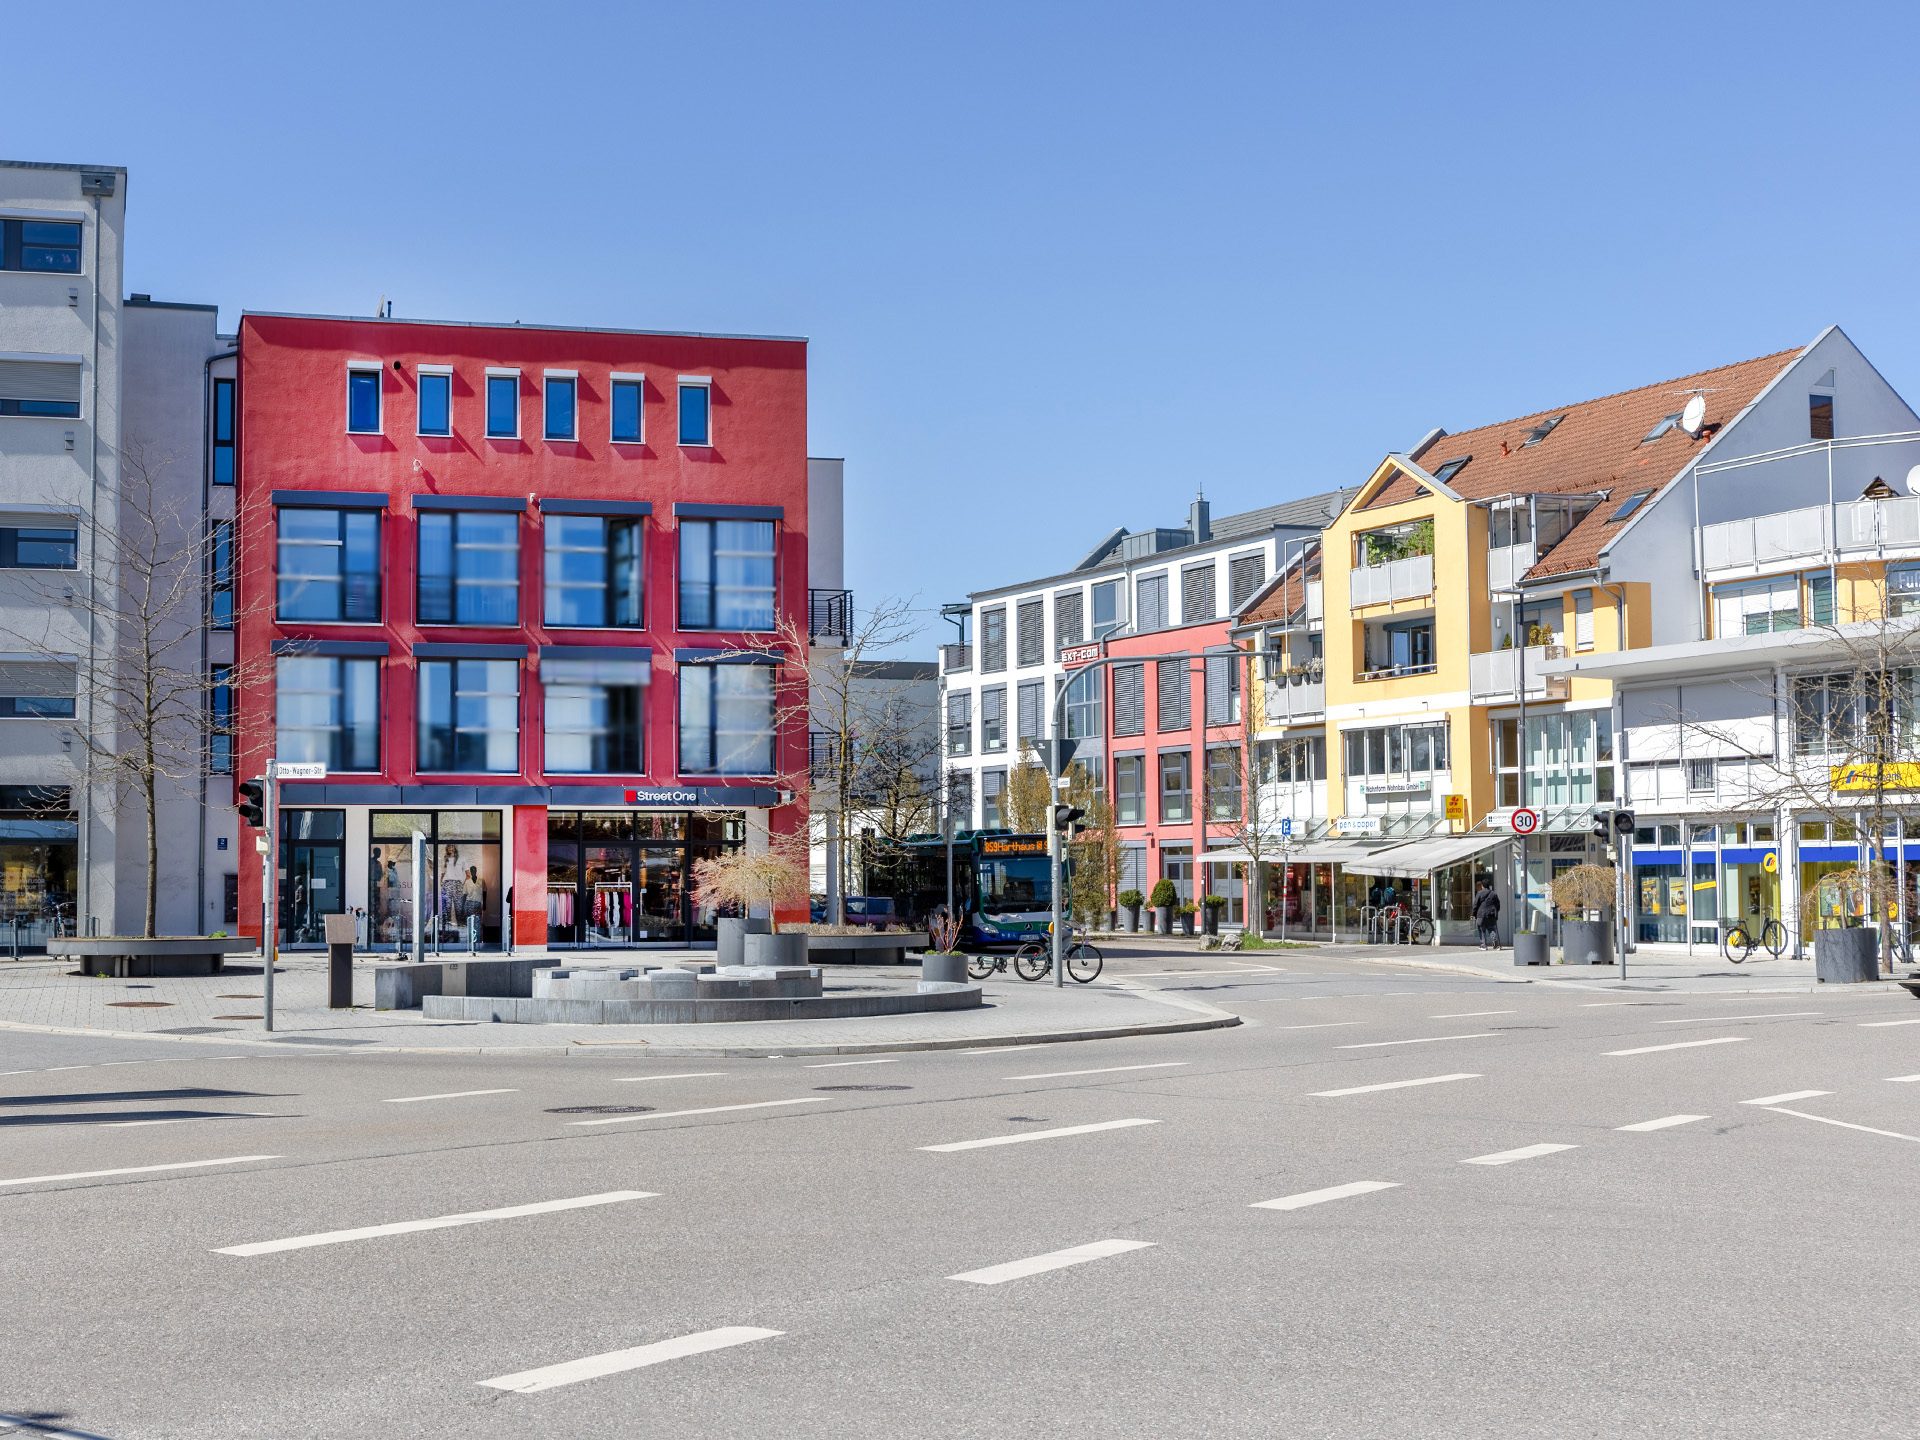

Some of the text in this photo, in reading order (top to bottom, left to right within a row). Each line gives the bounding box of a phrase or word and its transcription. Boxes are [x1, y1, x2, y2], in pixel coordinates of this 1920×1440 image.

[637, 791, 697, 801] Street One
[1516, 815, 1532, 827] 30
